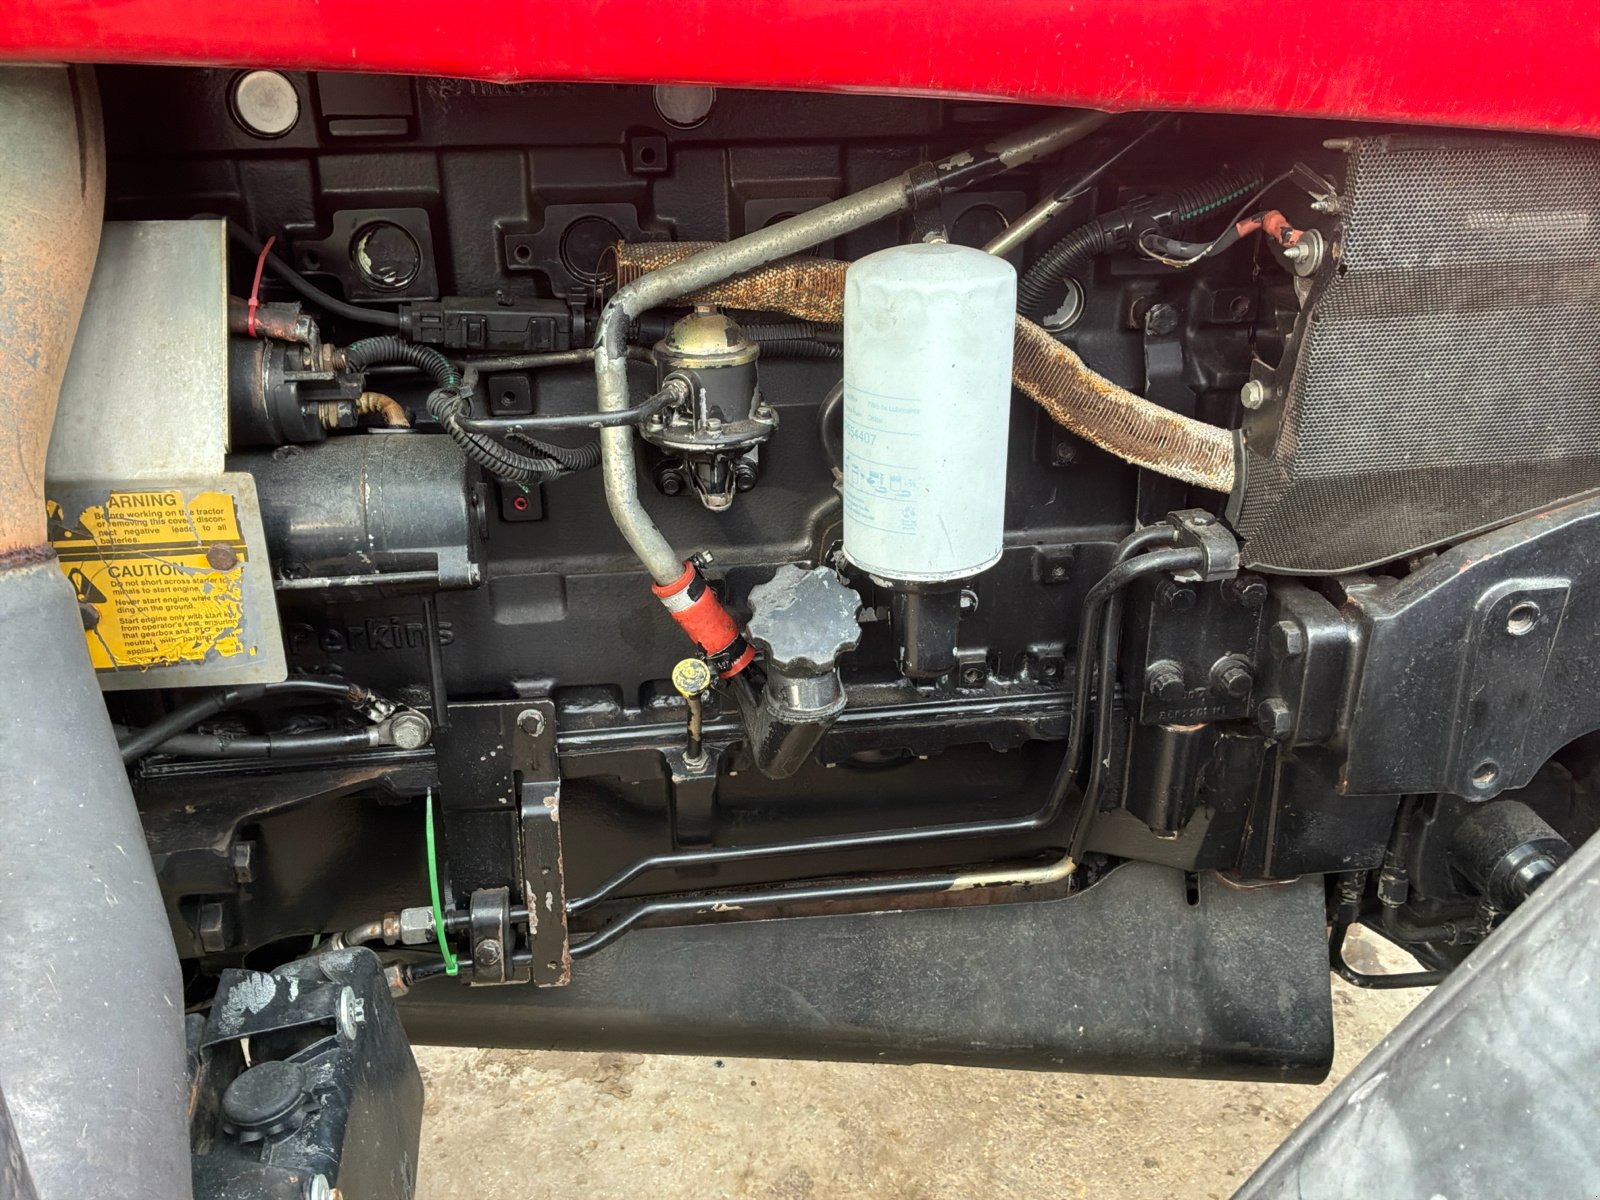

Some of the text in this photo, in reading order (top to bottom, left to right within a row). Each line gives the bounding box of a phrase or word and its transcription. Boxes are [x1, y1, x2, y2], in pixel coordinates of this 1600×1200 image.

[109, 493, 177, 508] ARNING
[94, 512, 125, 520] Beore
[127, 510, 163, 518] working
[98, 529, 117, 537] nect
[124, 528, 160, 536] negative
[100, 536, 140, 545] batteries.
[108, 562, 184, 579] CAUTION
[110, 580, 123, 588] Do
[163, 596, 190, 604] engine
[117, 606, 135, 614] ding
[165, 603, 196, 611] ground.
[141, 616, 168, 624] engine
[169, 614, 186, 622] only
[121, 624, 140, 632] from
[142, 621, 182, 631] operator's
[122, 632, 139, 640] that
[140, 629, 174, 639] gearbox
[175, 627, 190, 635] and
